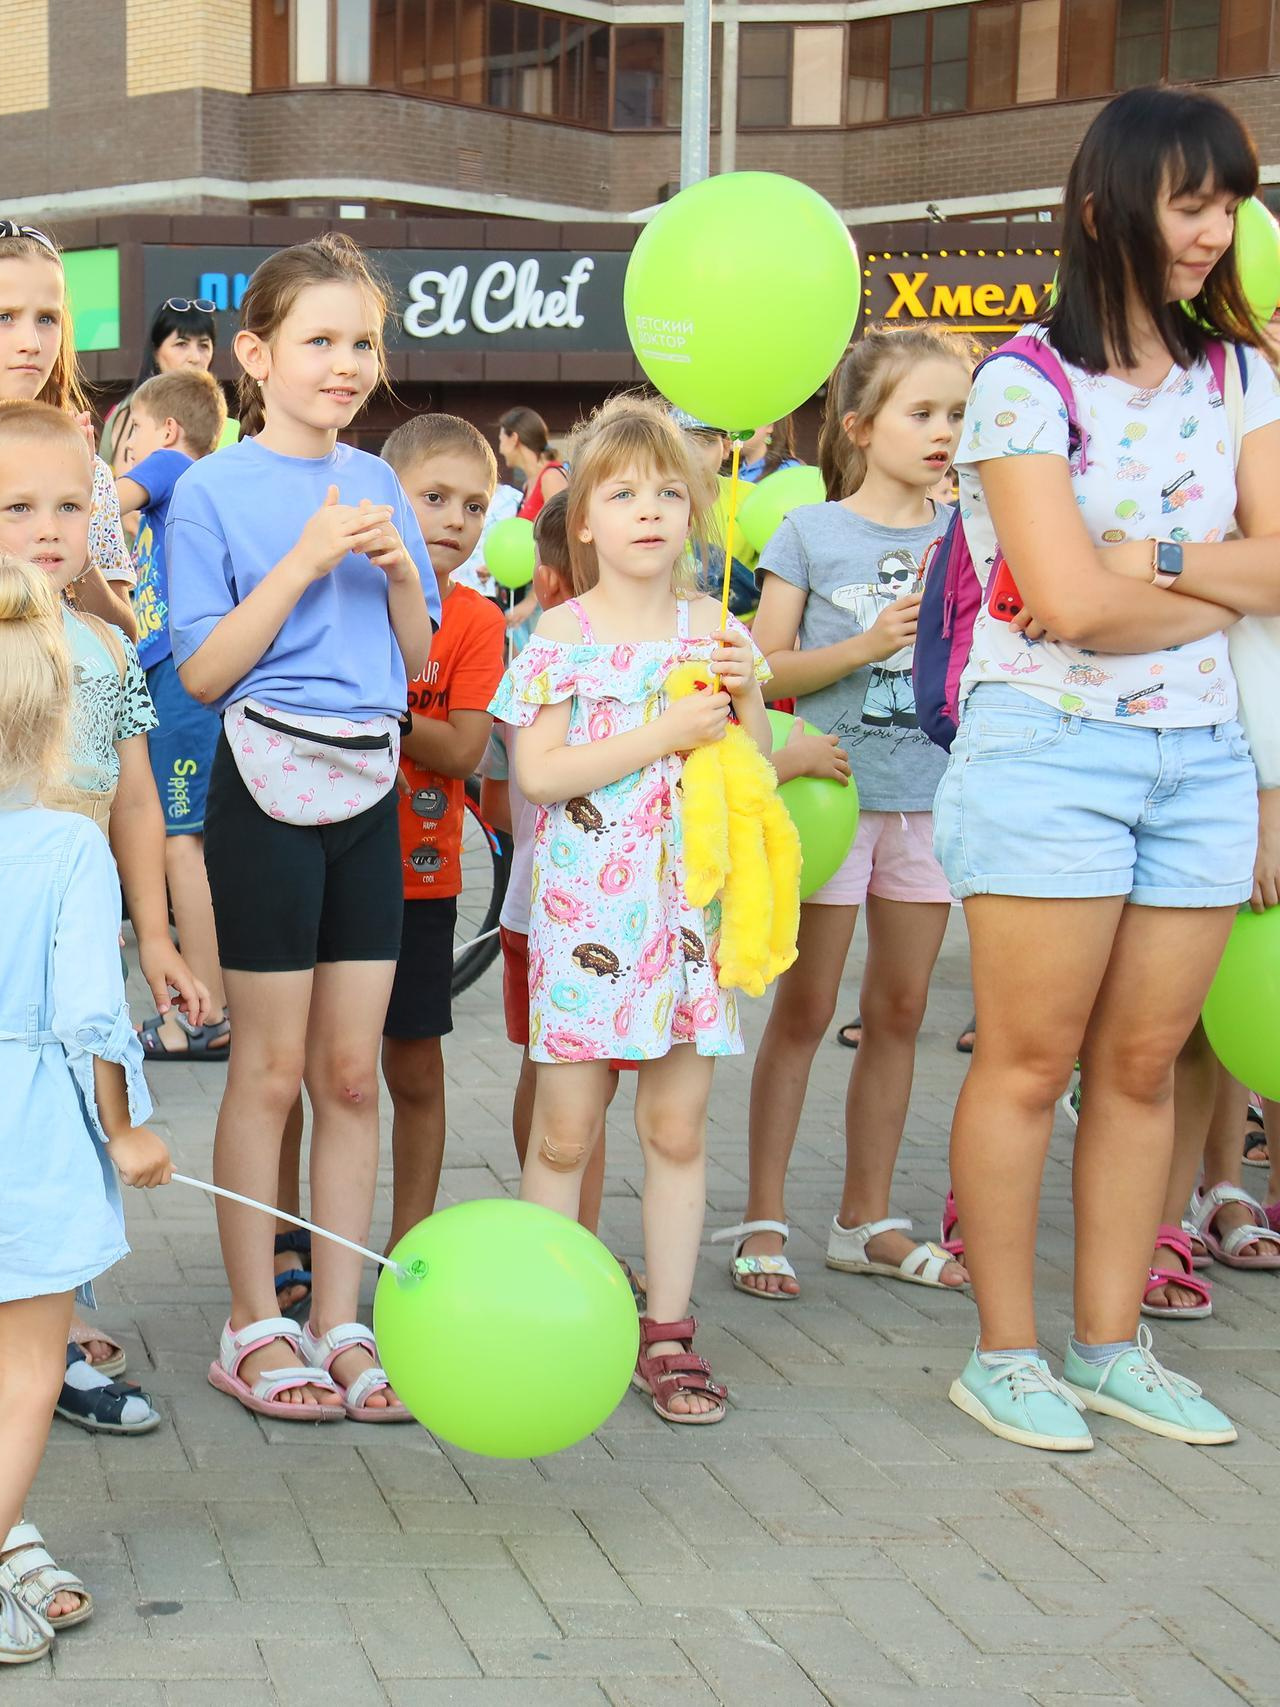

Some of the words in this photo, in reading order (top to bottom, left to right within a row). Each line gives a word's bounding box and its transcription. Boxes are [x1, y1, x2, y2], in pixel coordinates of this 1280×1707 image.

[403, 264, 469, 338] El
[470, 256, 595, 334] Chef
[884, 271, 1054, 318] Хмел
[169, 758, 197, 815] Sport
[422, 821, 438, 831] HAPPY
[422, 875, 435, 884] COOL
